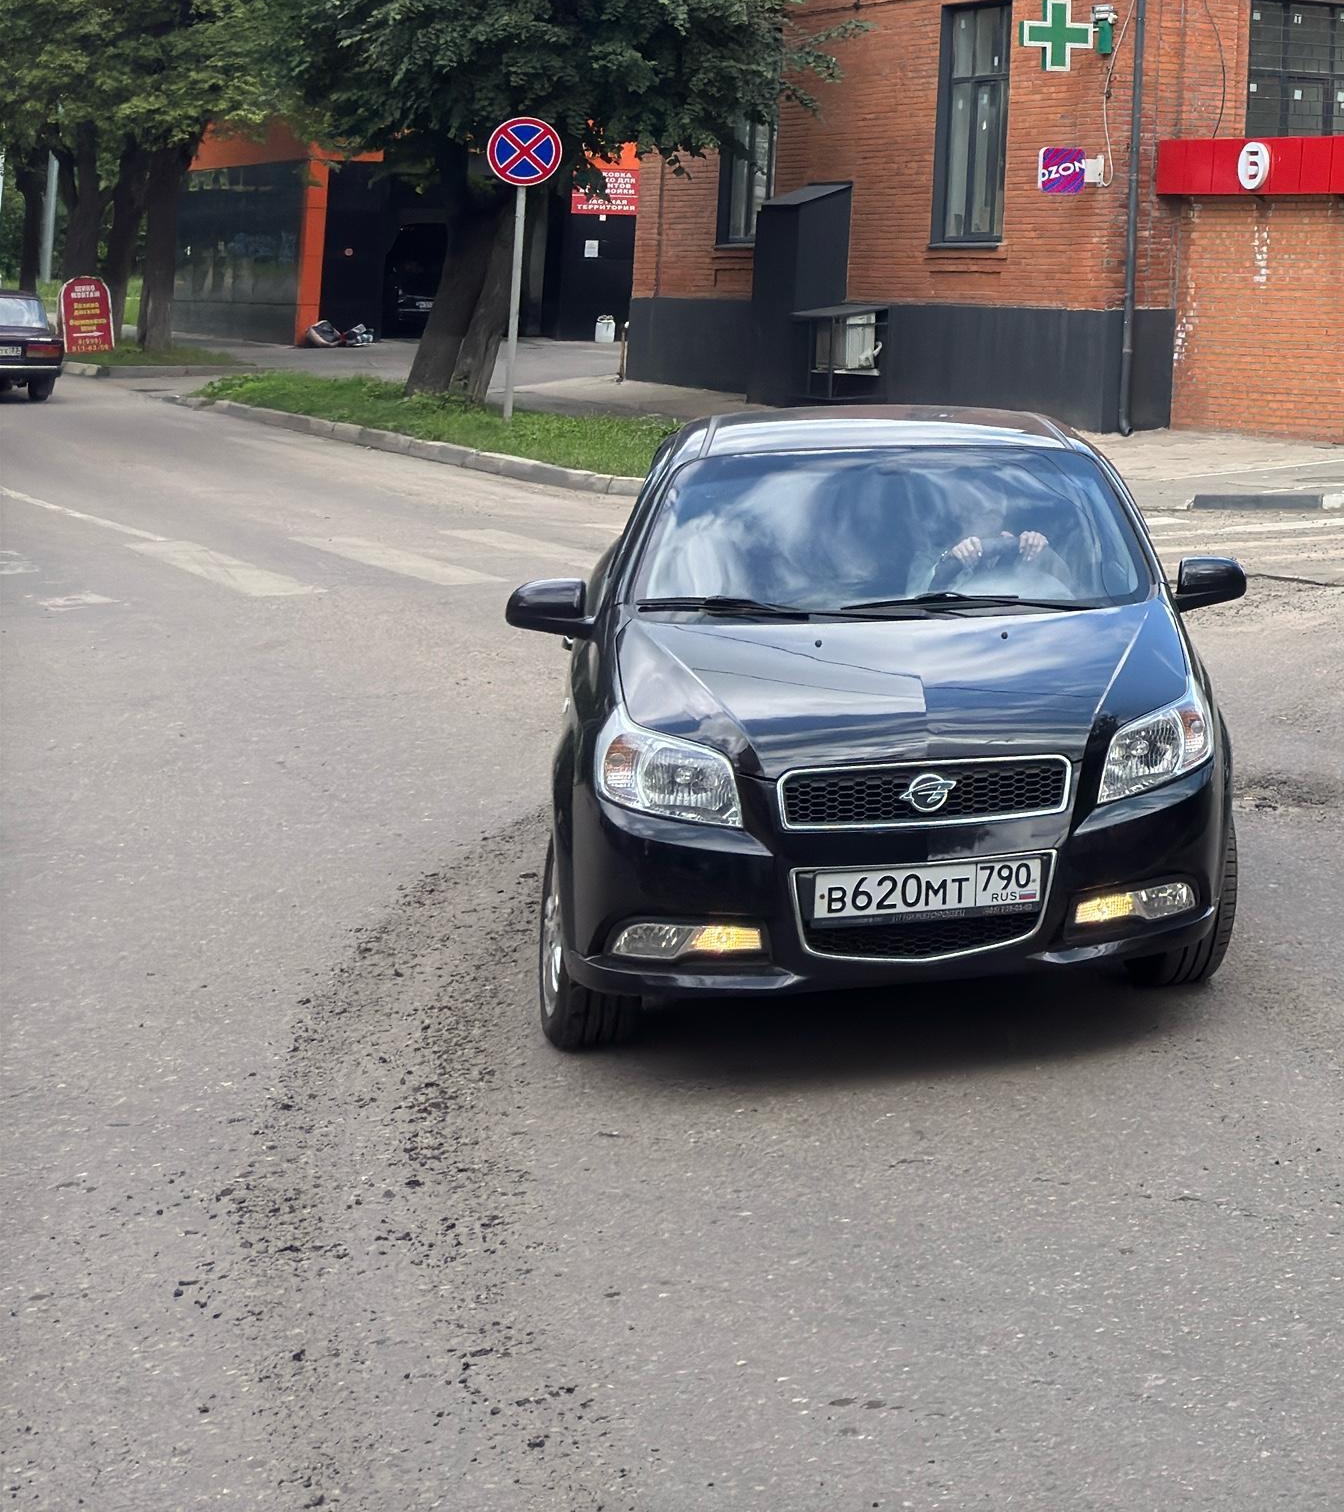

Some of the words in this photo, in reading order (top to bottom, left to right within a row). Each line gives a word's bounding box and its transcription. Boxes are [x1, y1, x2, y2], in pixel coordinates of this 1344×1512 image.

[827, 873, 970, 914] В620МТ
[979, 862, 1031, 892] 790
[991, 891, 1018, 902] RUS
